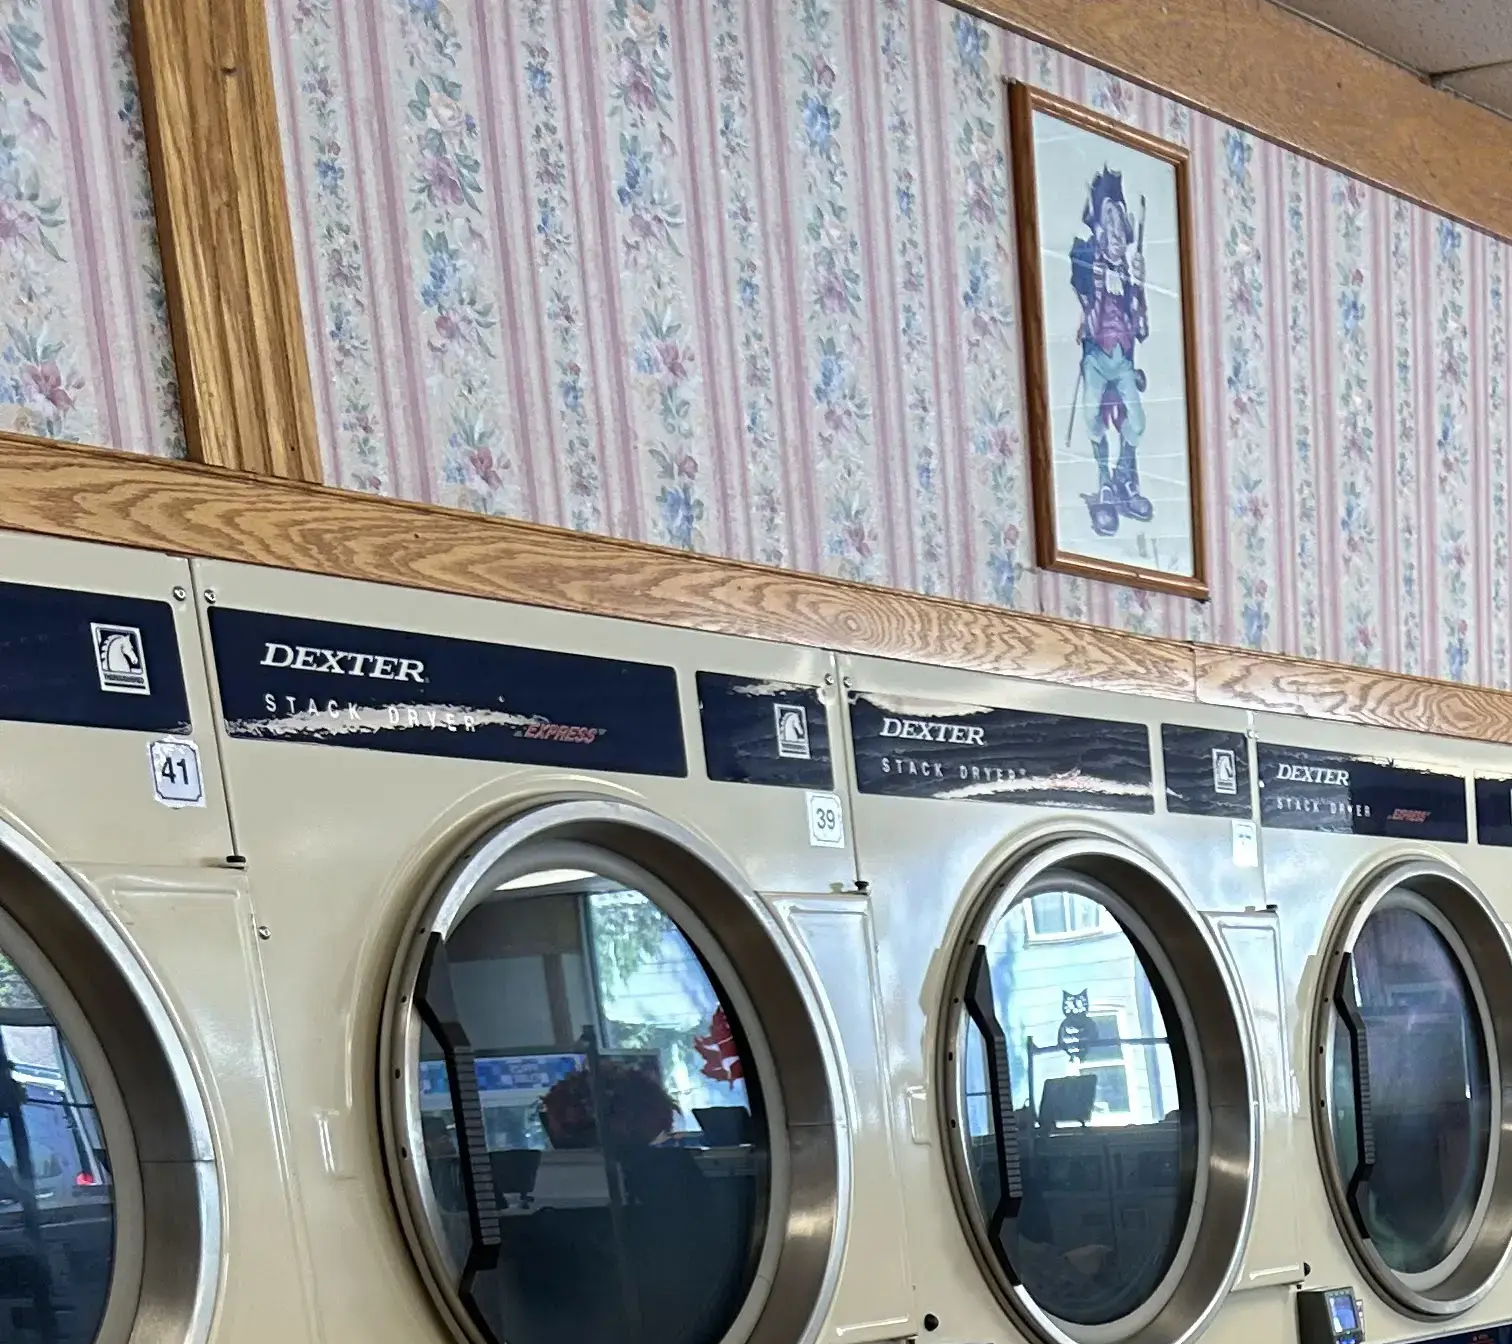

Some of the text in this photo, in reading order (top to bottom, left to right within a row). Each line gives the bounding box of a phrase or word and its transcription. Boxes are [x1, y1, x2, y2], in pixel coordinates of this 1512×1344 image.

[260, 642, 425, 683] DEXTER
[265, 693, 598, 743] STACK DRYER EXPRESS
[880, 717, 985, 746] DEXTER
[161, 757, 189, 785] 41
[881, 756, 944, 777] STACK
[1276, 762, 1349, 786] DEXTER
[1276, 795, 1320, 813] STACK
[816, 808, 835, 830] 39
